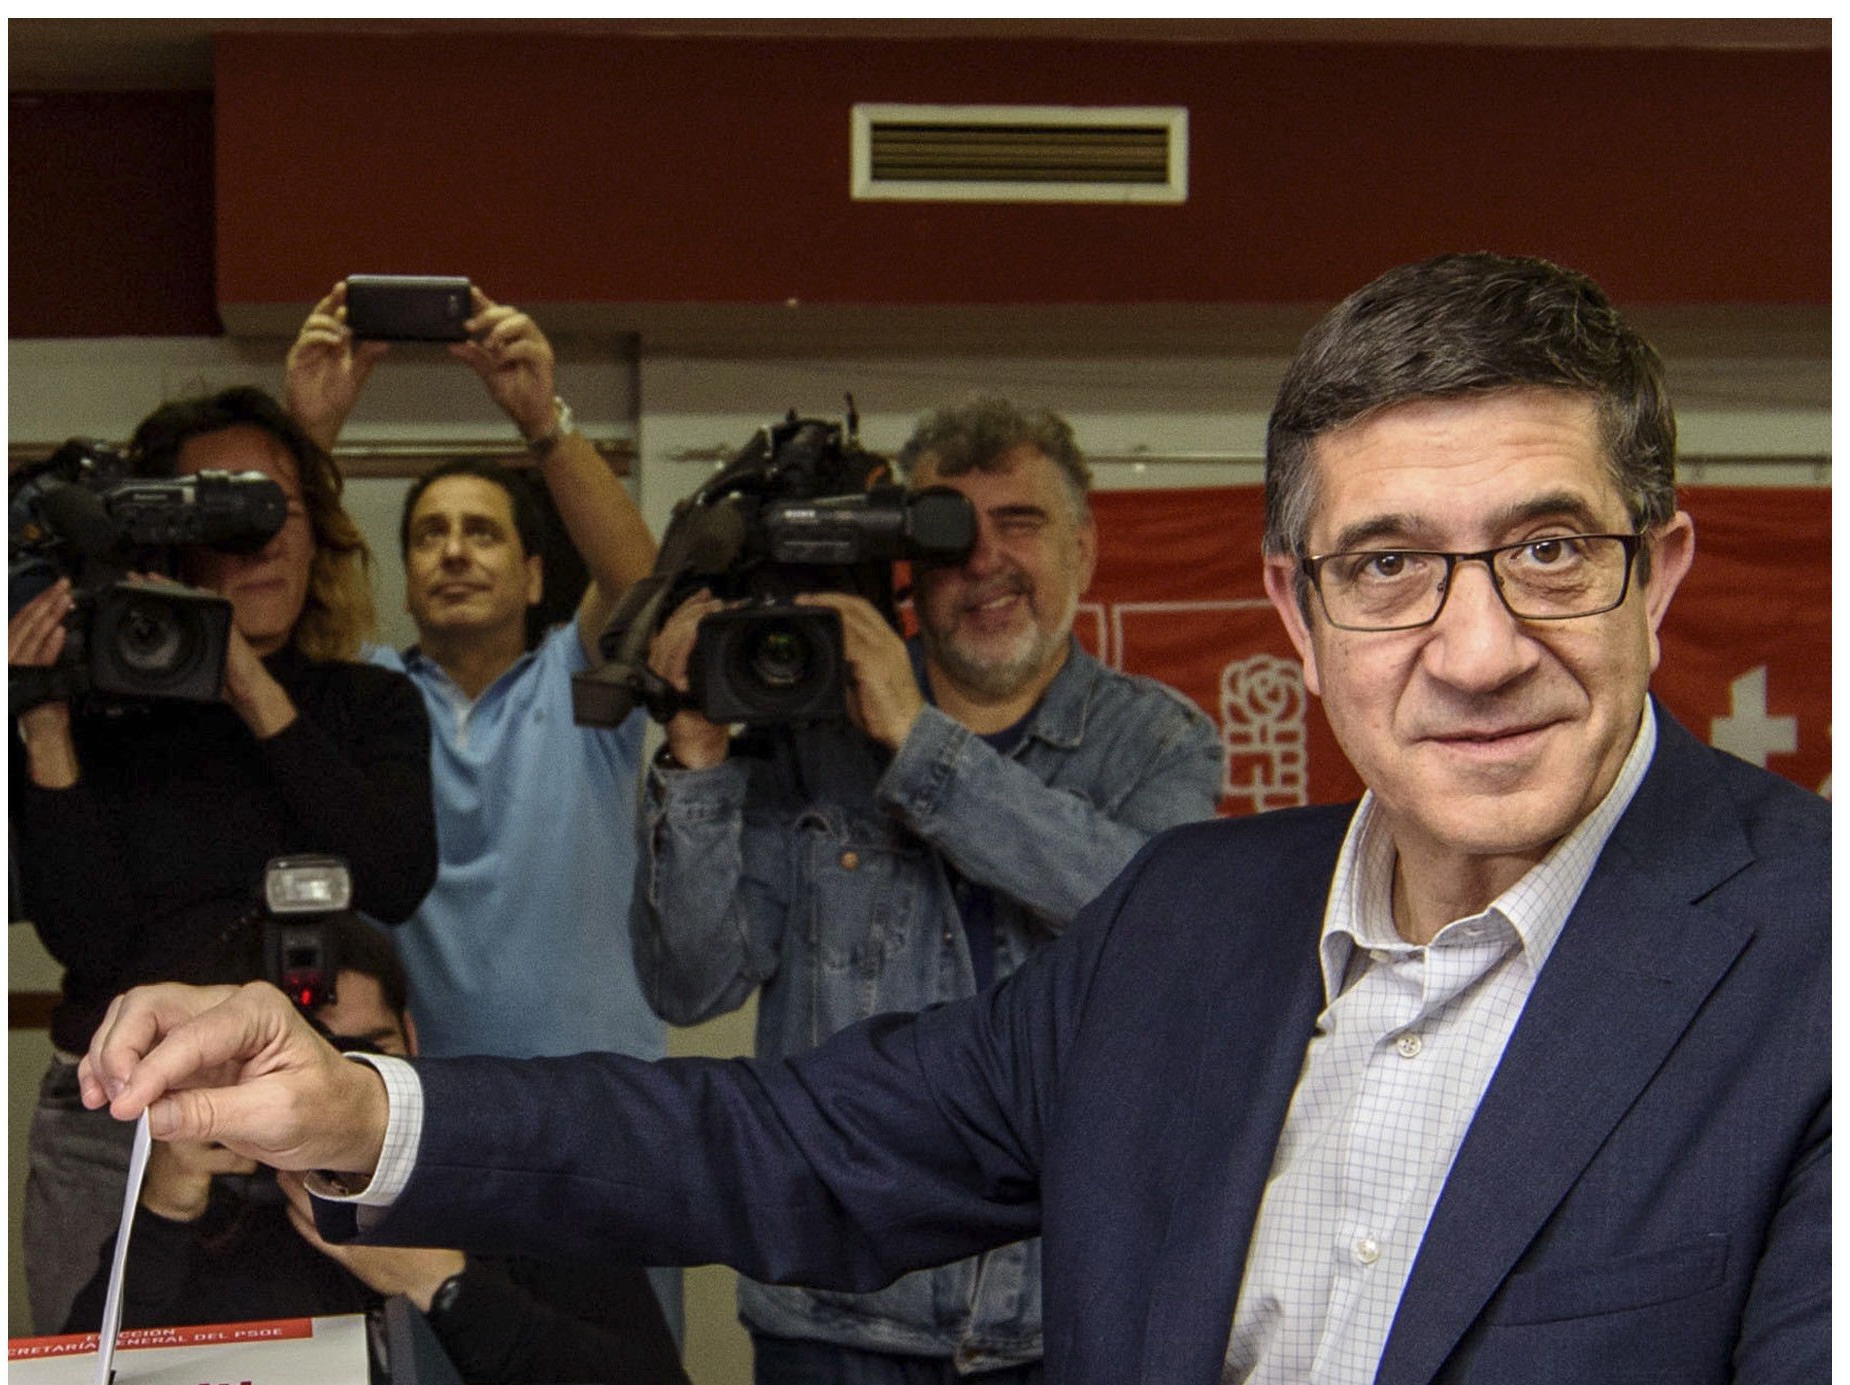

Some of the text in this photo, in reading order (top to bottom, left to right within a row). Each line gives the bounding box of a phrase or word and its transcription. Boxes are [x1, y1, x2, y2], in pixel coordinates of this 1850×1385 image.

[116, 1334, 185, 1346] ENERAL
[194, 1331, 227, 1341] DEL
[234, 1328, 282, 1338] PSOE
